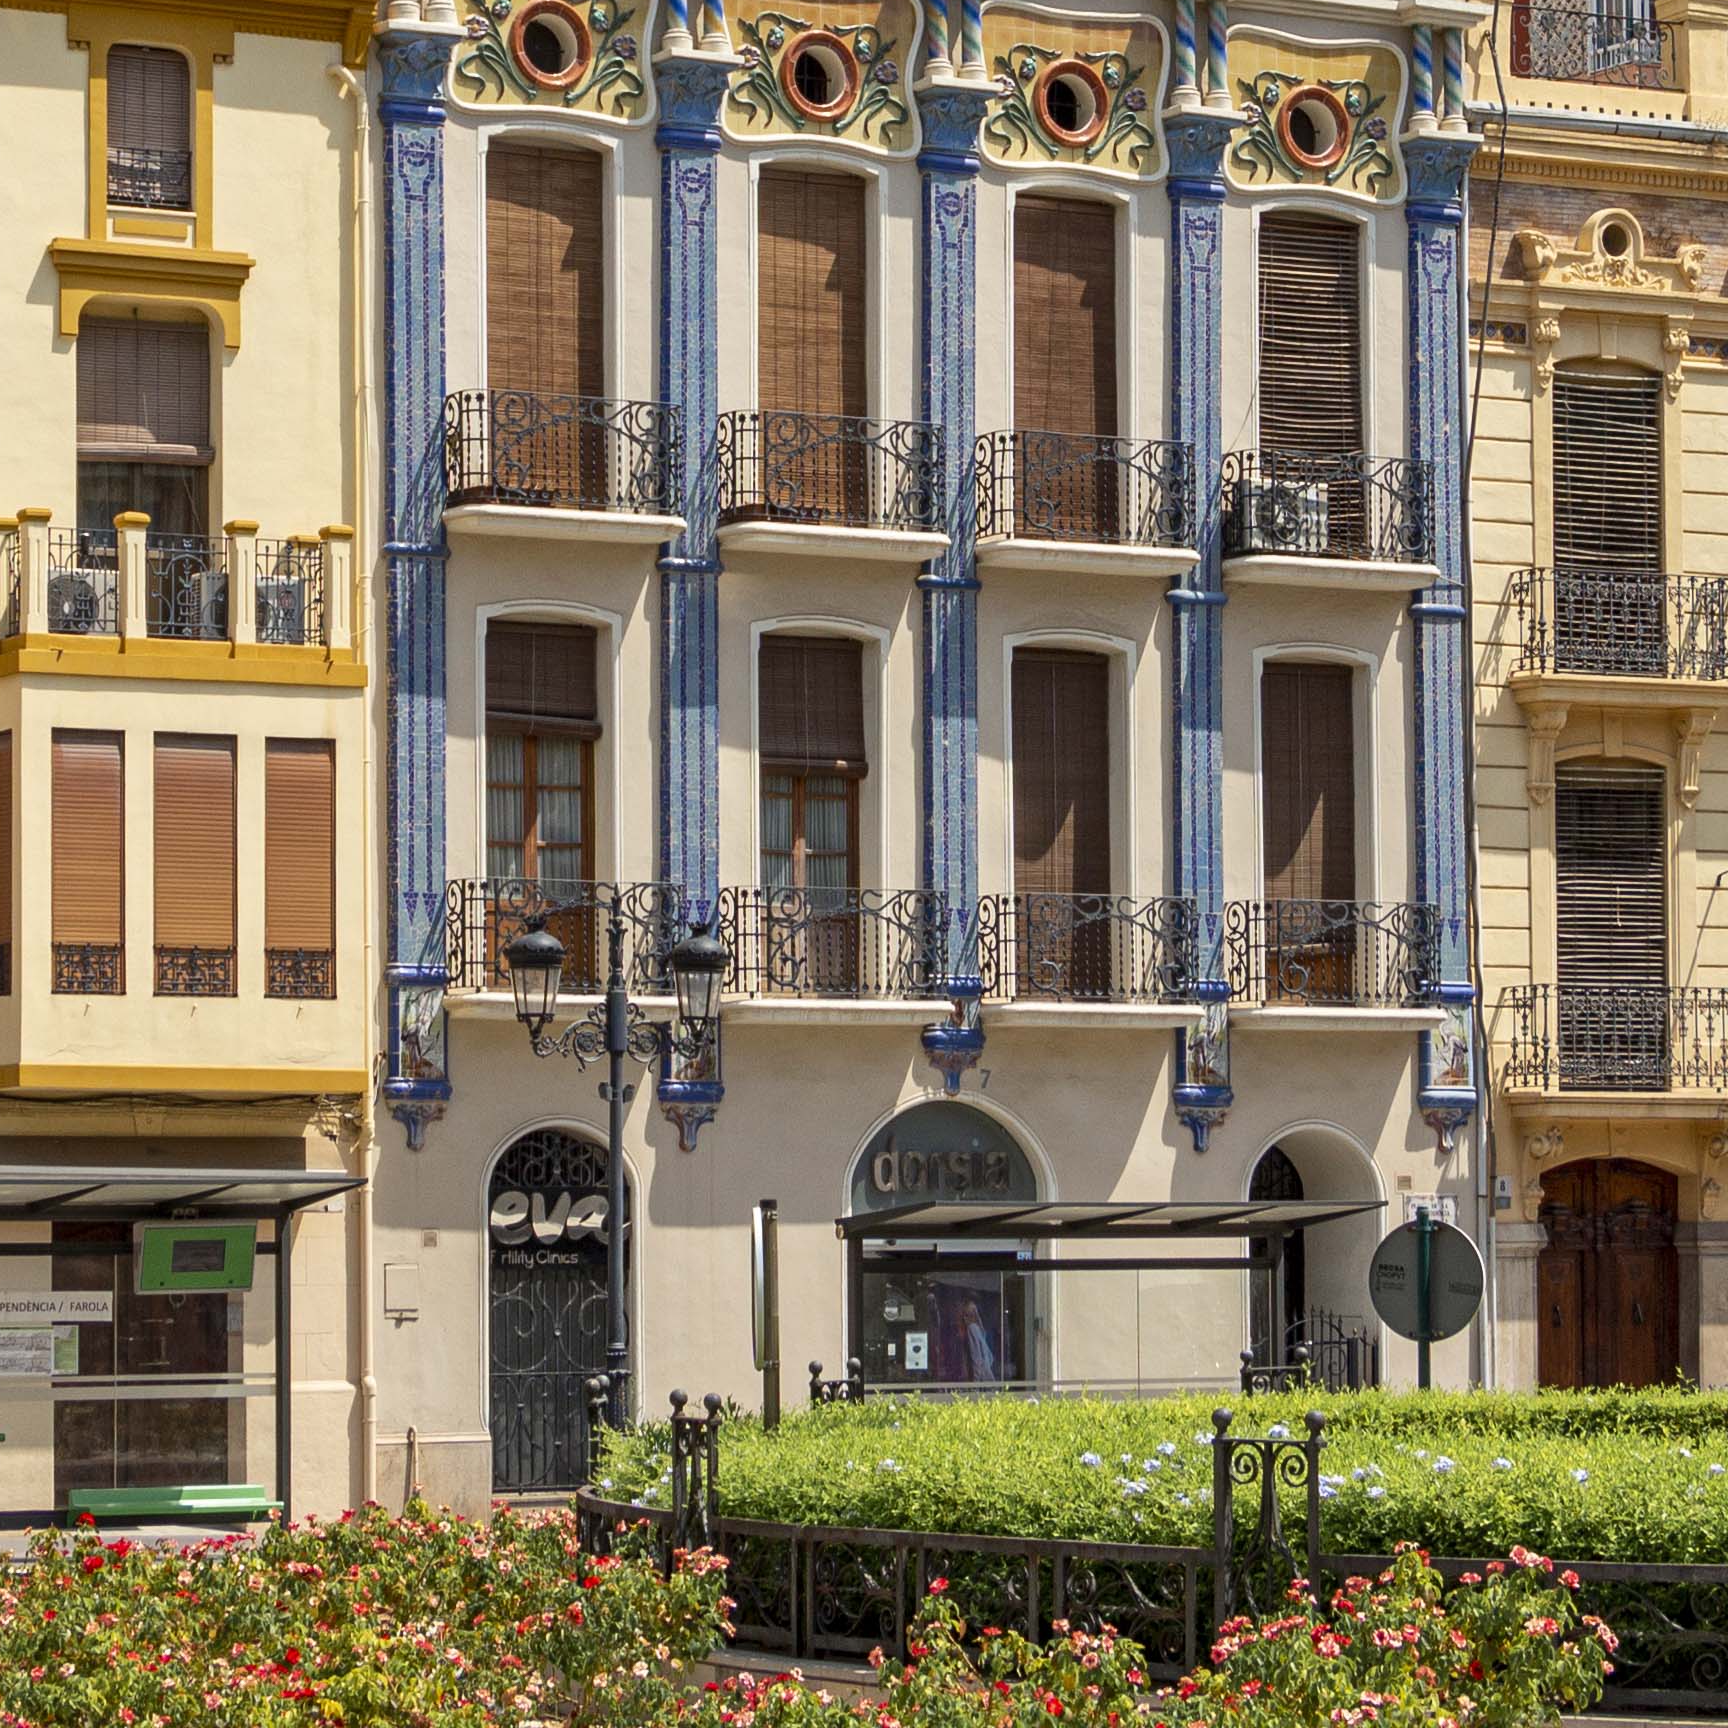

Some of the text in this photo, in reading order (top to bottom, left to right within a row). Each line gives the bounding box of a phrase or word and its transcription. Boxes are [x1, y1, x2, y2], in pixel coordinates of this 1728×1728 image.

[980, 1068, 992, 1089] 7
[490, 1190, 632, 1246] eva
[536, 1249, 579, 1265] Clinics
[69, 1301, 109, 1313] FAROLA
